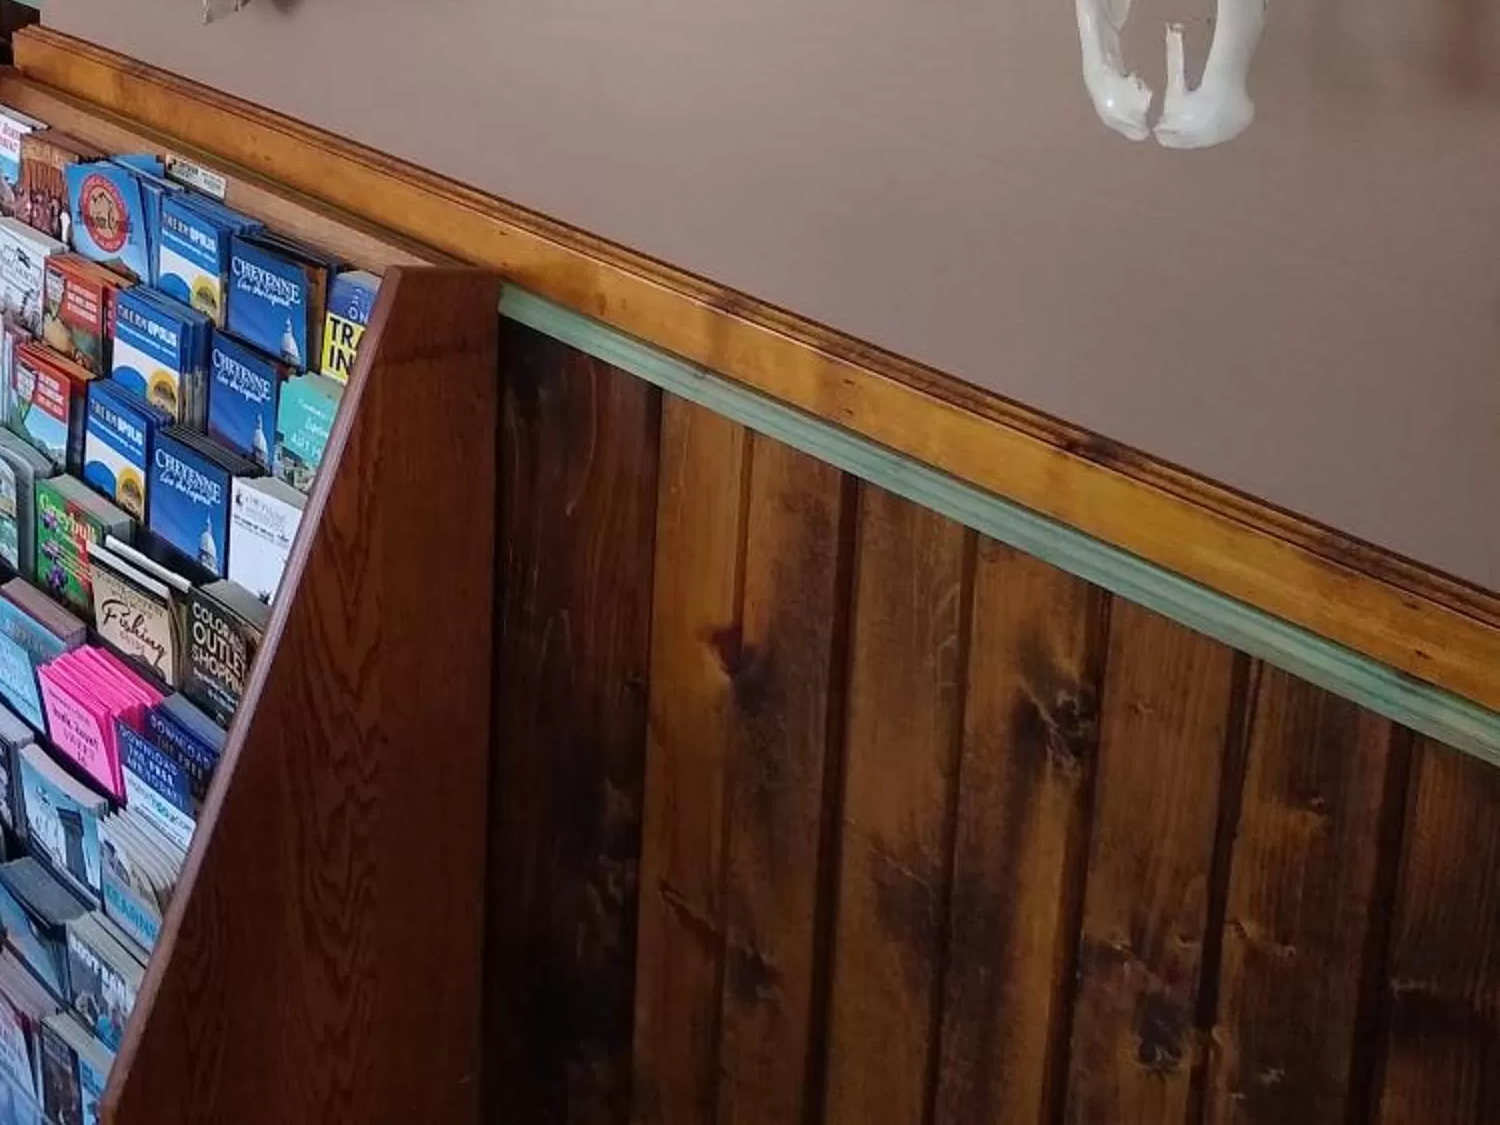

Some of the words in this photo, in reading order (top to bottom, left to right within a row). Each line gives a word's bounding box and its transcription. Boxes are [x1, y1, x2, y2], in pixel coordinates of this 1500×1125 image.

[231, 256, 301, 304] CHEYENNE
[212, 348, 272, 401] CHEYENNE
[155, 448, 221, 505] CHEYENNE
[102, 598, 165, 668] Fishing
[193, 622, 247, 678] OUTLET
